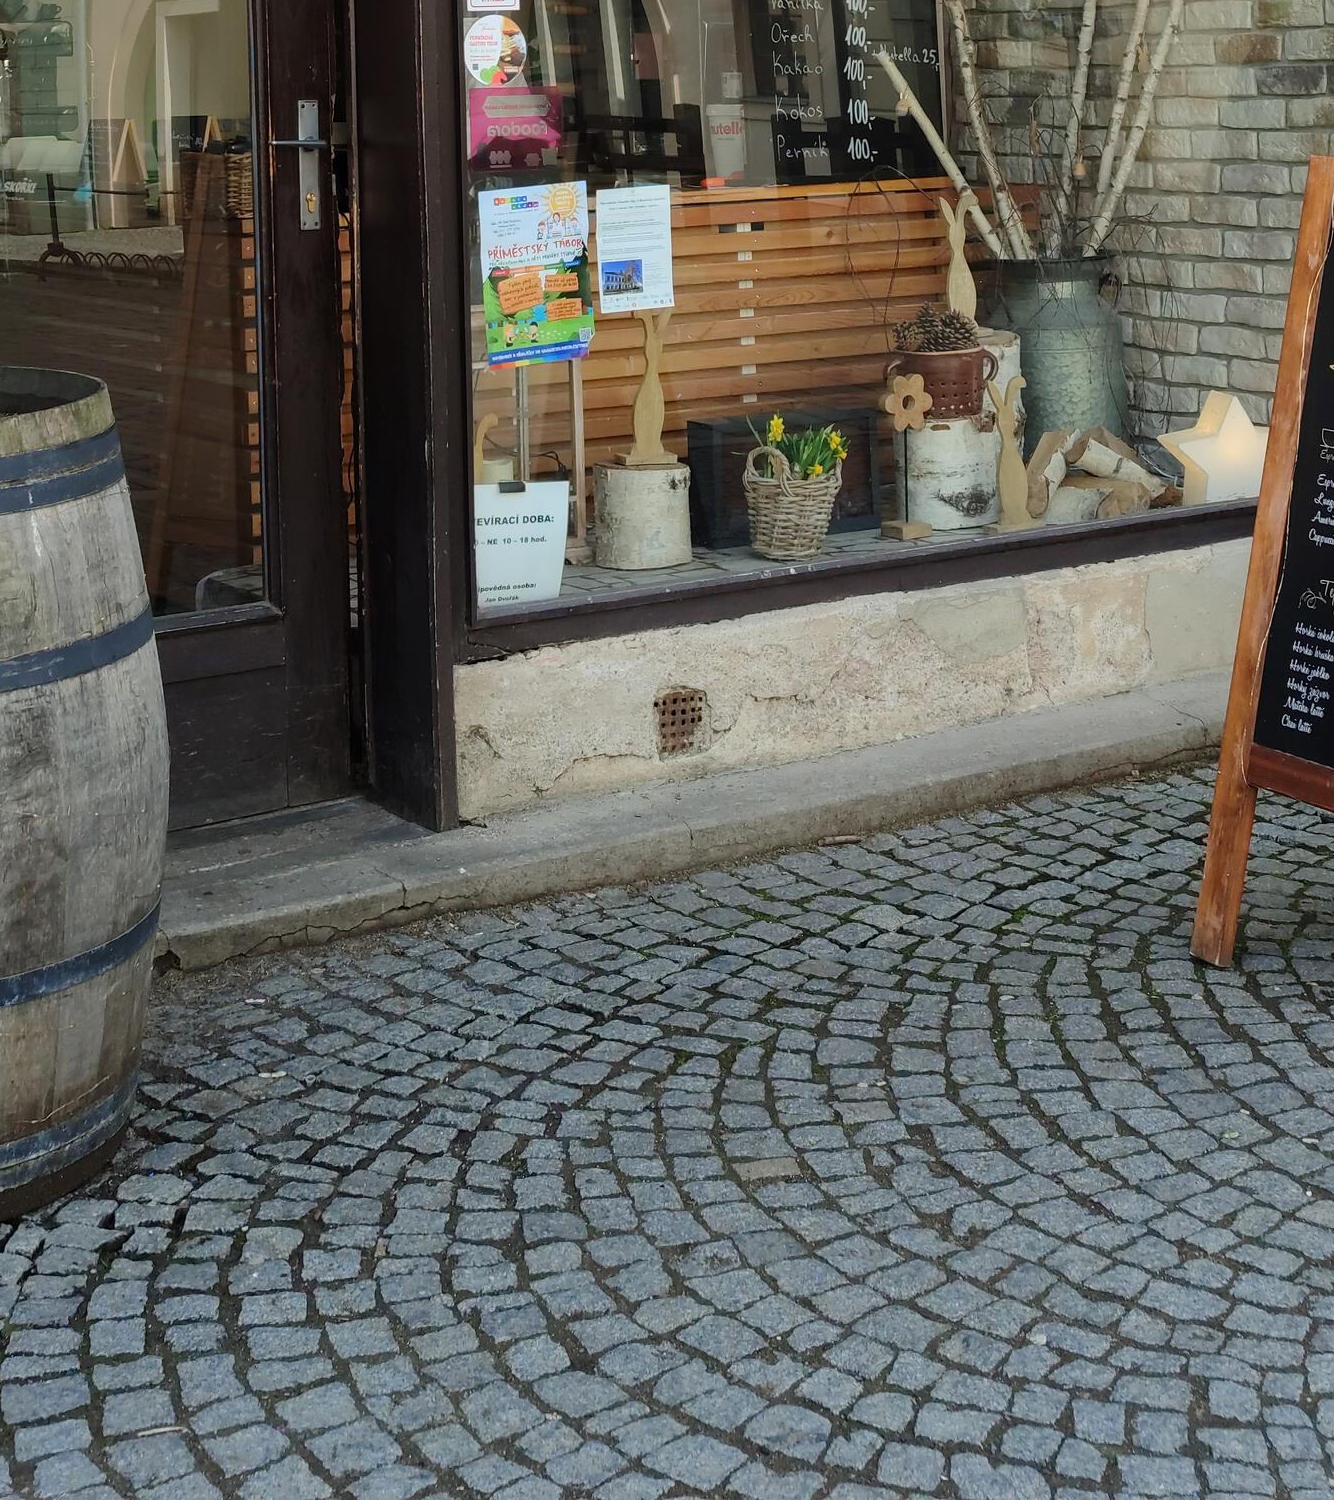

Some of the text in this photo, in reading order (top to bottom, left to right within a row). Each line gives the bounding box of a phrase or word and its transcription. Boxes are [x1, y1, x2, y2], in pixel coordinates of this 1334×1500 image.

[771, 20, 872, 53] Ořech 100,-
[773, 52, 873, 90] Kakao 100,-
[775, 98, 876, 130] Kokos 100,-
[777, 134, 878, 162] Perník 100,-
[488, 237, 584, 260] PŘÍMĚSTSKÝ TÁBOR
[522, 514, 555, 524] DOBA:
